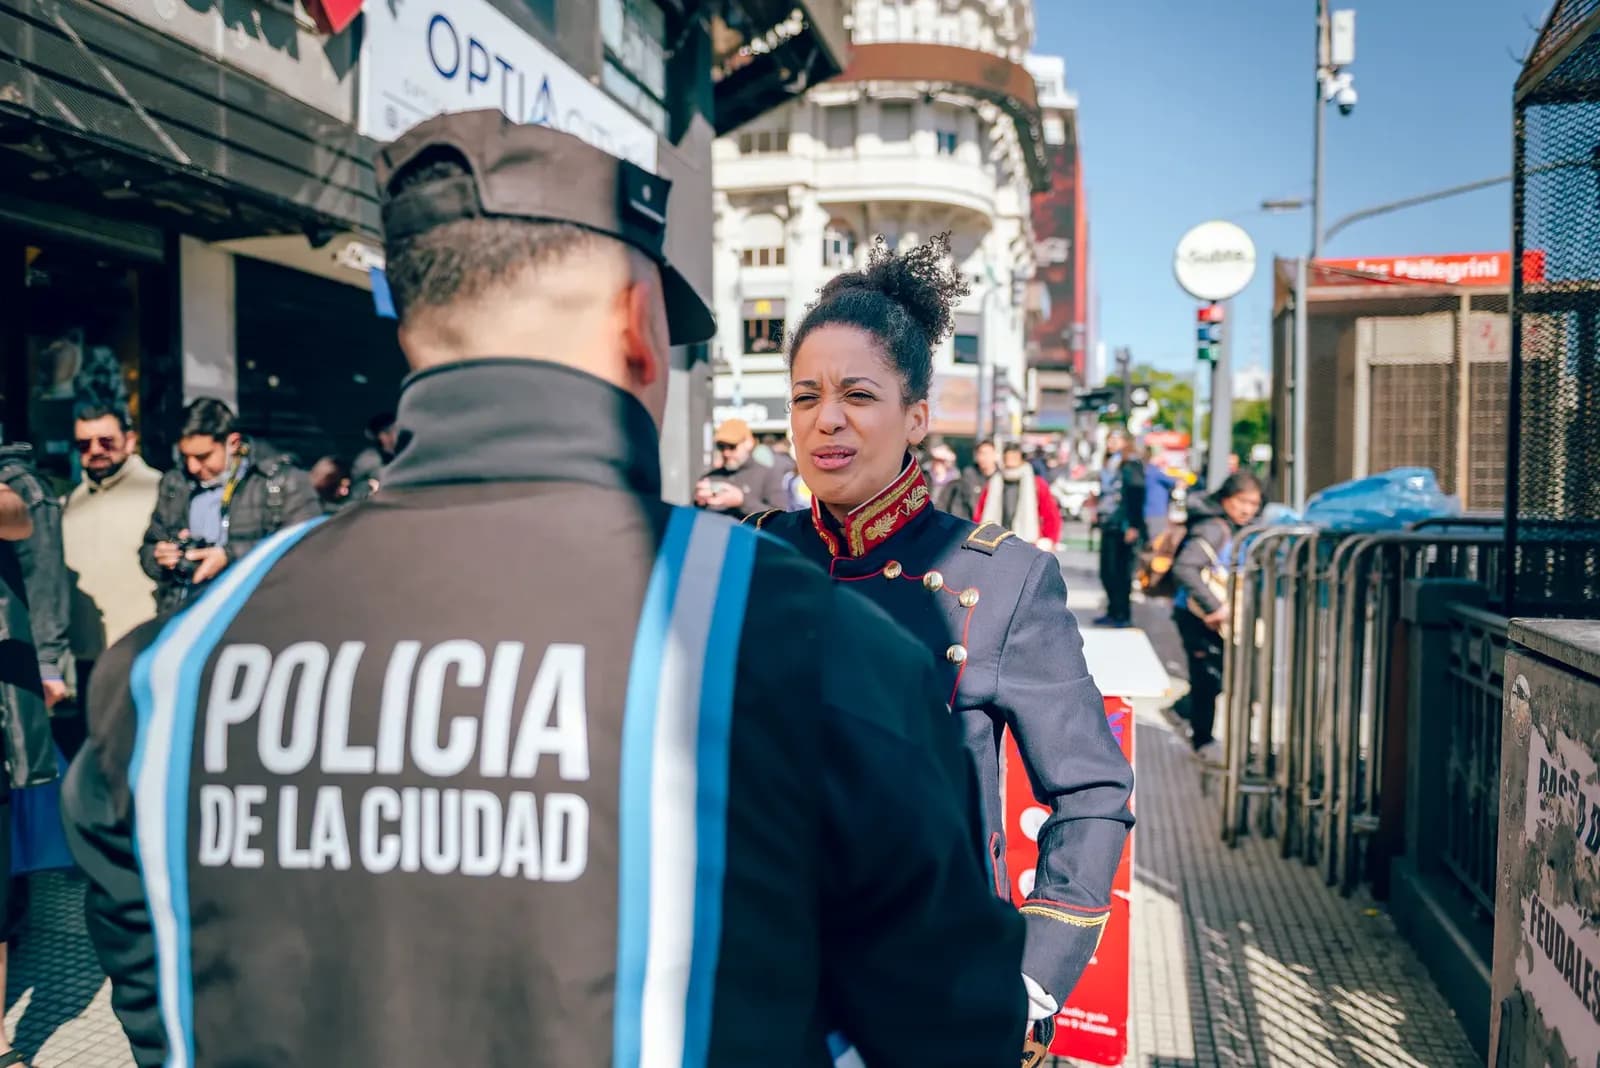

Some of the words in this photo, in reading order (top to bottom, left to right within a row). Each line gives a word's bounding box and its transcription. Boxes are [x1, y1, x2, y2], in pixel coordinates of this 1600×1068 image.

[1394, 256, 1500, 283] Pellegrini
[204, 639, 590, 781] POLICIA
[199, 784, 267, 868] DE
[278, 785, 351, 870] LA
[360, 786, 590, 883] CIUDAD
[1530, 894, 1600, 1026] FEUDALES
